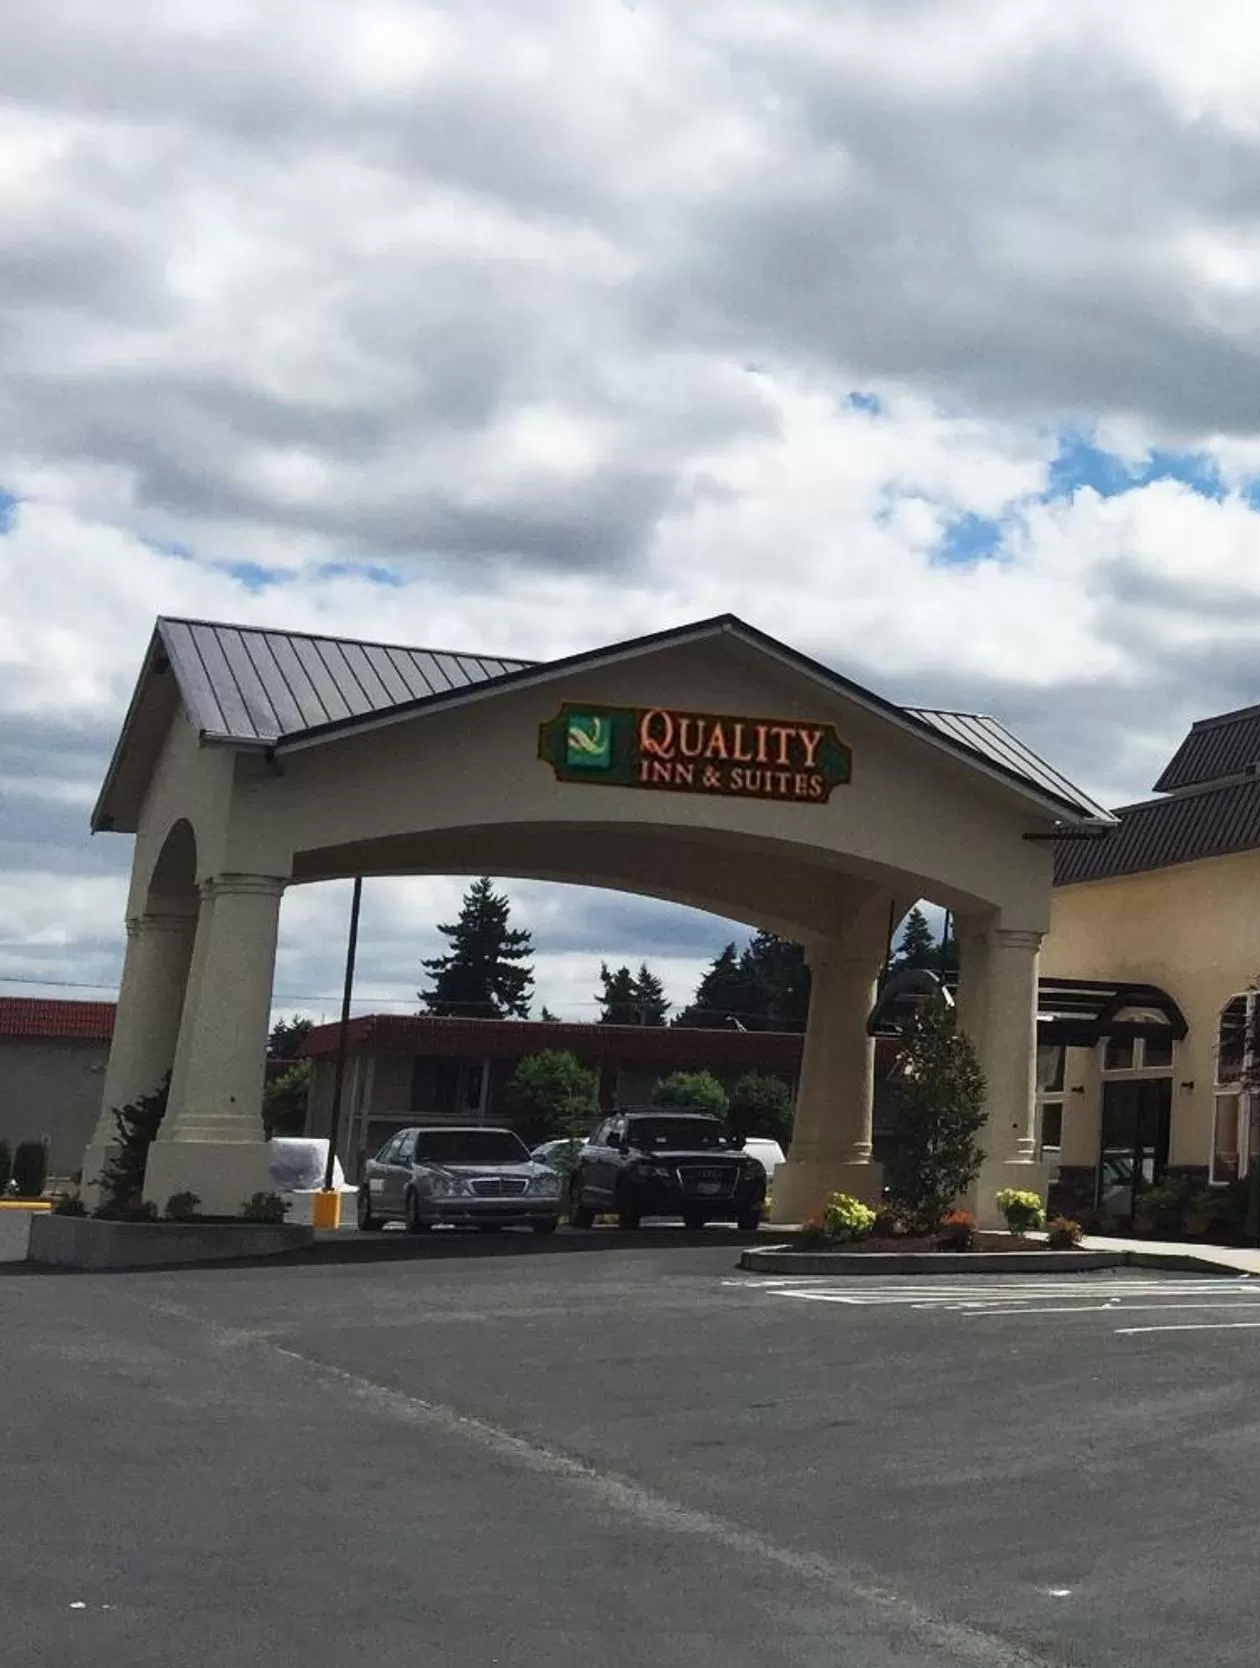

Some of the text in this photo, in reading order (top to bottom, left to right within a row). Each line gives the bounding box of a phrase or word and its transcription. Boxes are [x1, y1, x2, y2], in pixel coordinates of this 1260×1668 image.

[639, 707, 823, 767] QUALITY
[639, 760, 823, 797] INN & SUITES
